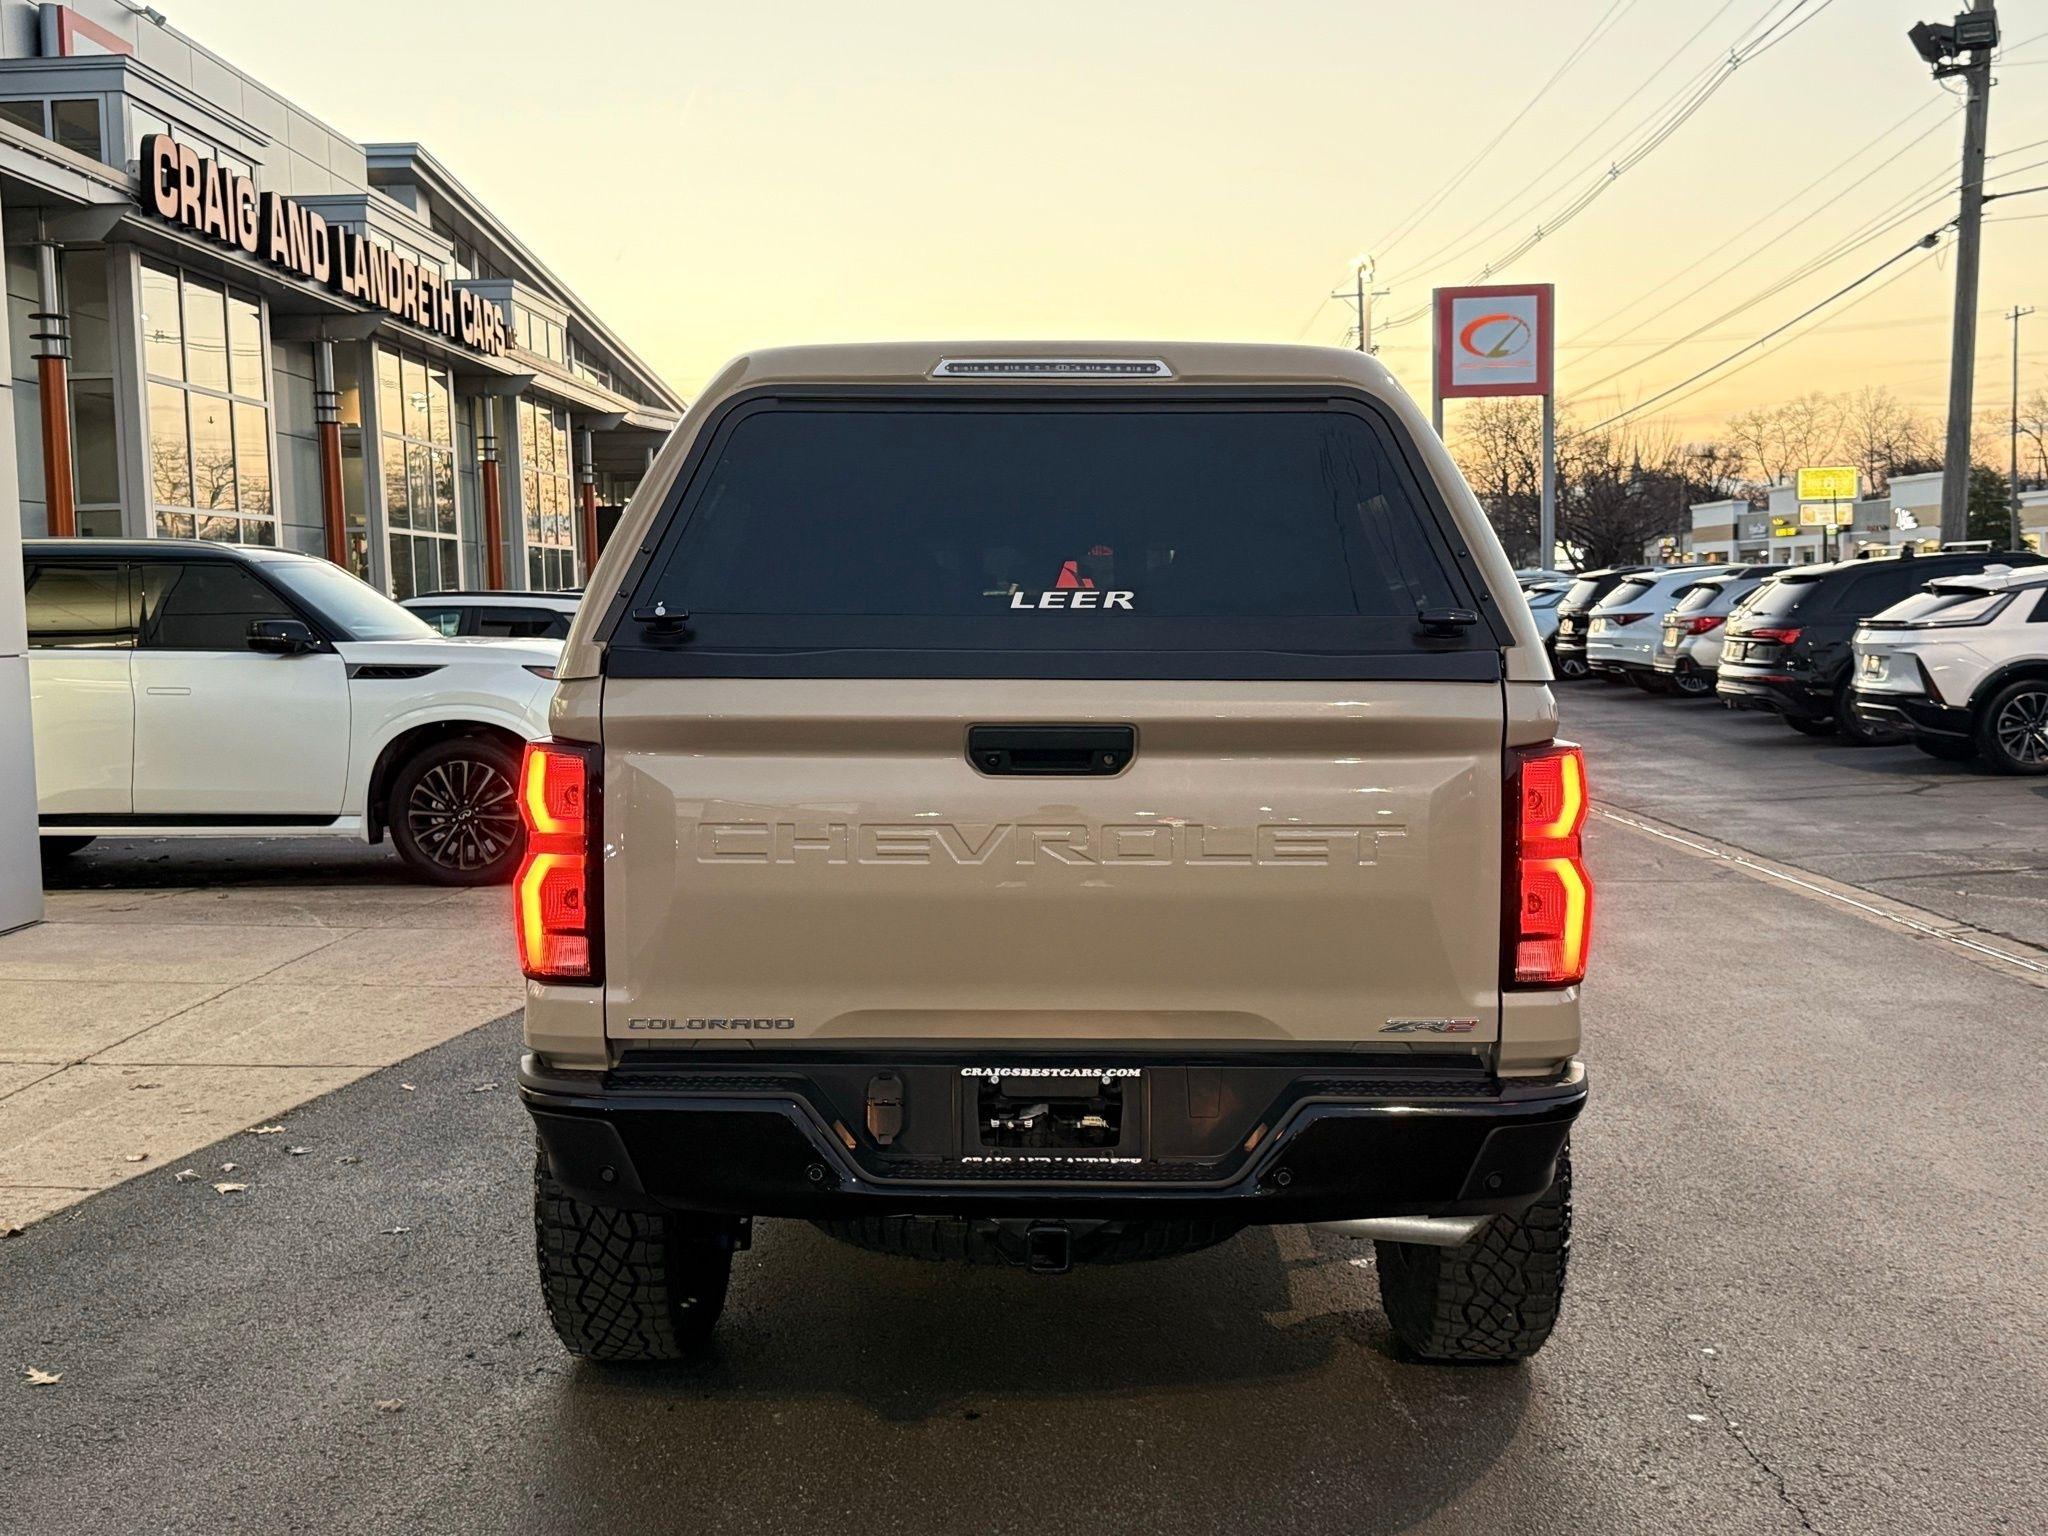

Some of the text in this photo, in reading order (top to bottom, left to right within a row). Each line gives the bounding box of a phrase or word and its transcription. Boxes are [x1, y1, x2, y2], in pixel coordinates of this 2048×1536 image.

[151, 133, 506, 358] CRAIG AND LANDRETH CARS
[1010, 591, 1135, 610] LEER
[697, 822, 1407, 866] CHEVROLET
[628, 1017, 795, 1030] COLORADO
[960, 1067, 1142, 1078] CRAIGSBESTCARS.COM
